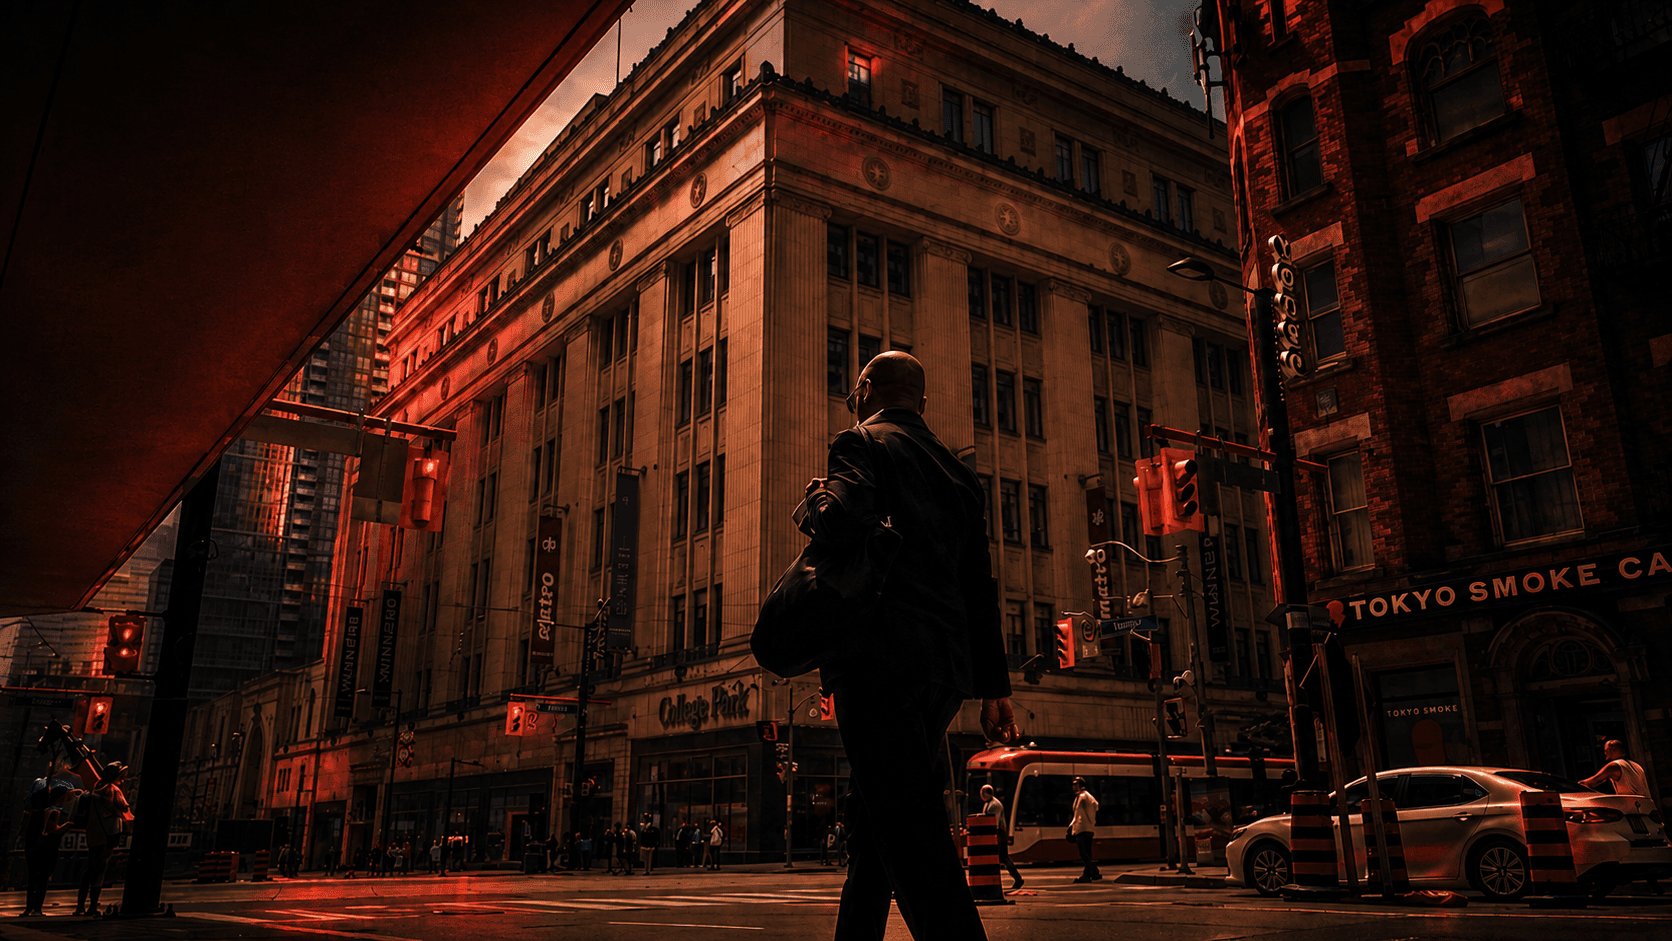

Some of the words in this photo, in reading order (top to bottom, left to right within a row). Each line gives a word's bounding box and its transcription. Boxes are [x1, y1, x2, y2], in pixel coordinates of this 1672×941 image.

[1348, 585, 1456, 621] TOKYO
[1469, 562, 1601, 603] SMOKE
[1618, 551, 1672, 580] CA
[659, 694, 709, 730] College
[711, 680, 750, 720] Park
[1386, 706, 1420, 718] TOKYO
[1423, 704, 1458, 715] SMOKE
